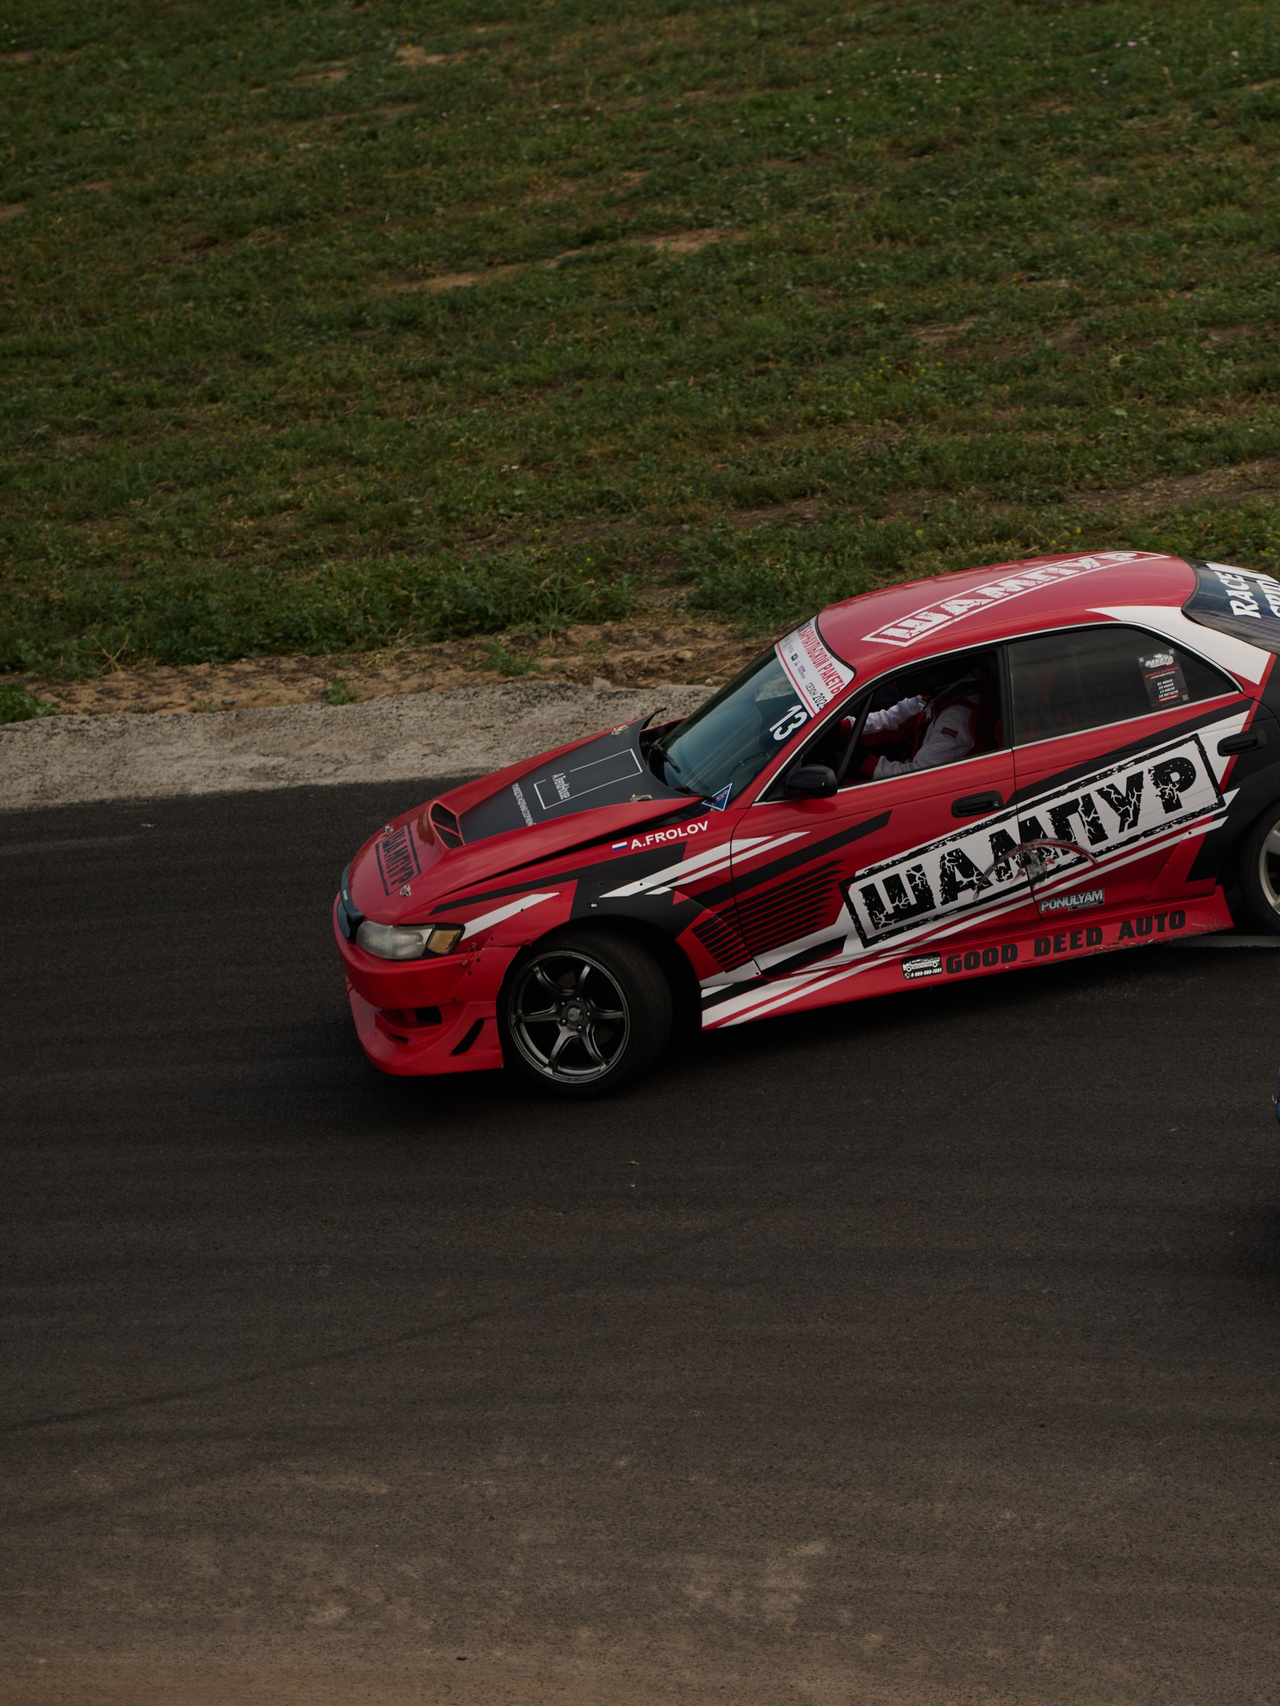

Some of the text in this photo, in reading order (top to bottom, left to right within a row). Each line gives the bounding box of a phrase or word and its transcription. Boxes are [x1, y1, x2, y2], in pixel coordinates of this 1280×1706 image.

[1214, 570, 1262, 619] RACE
[769, 704, 808, 741] 13
[631, 820, 709, 850] A.FROLOV
[859, 756, 1197, 930] ШАМПУР
